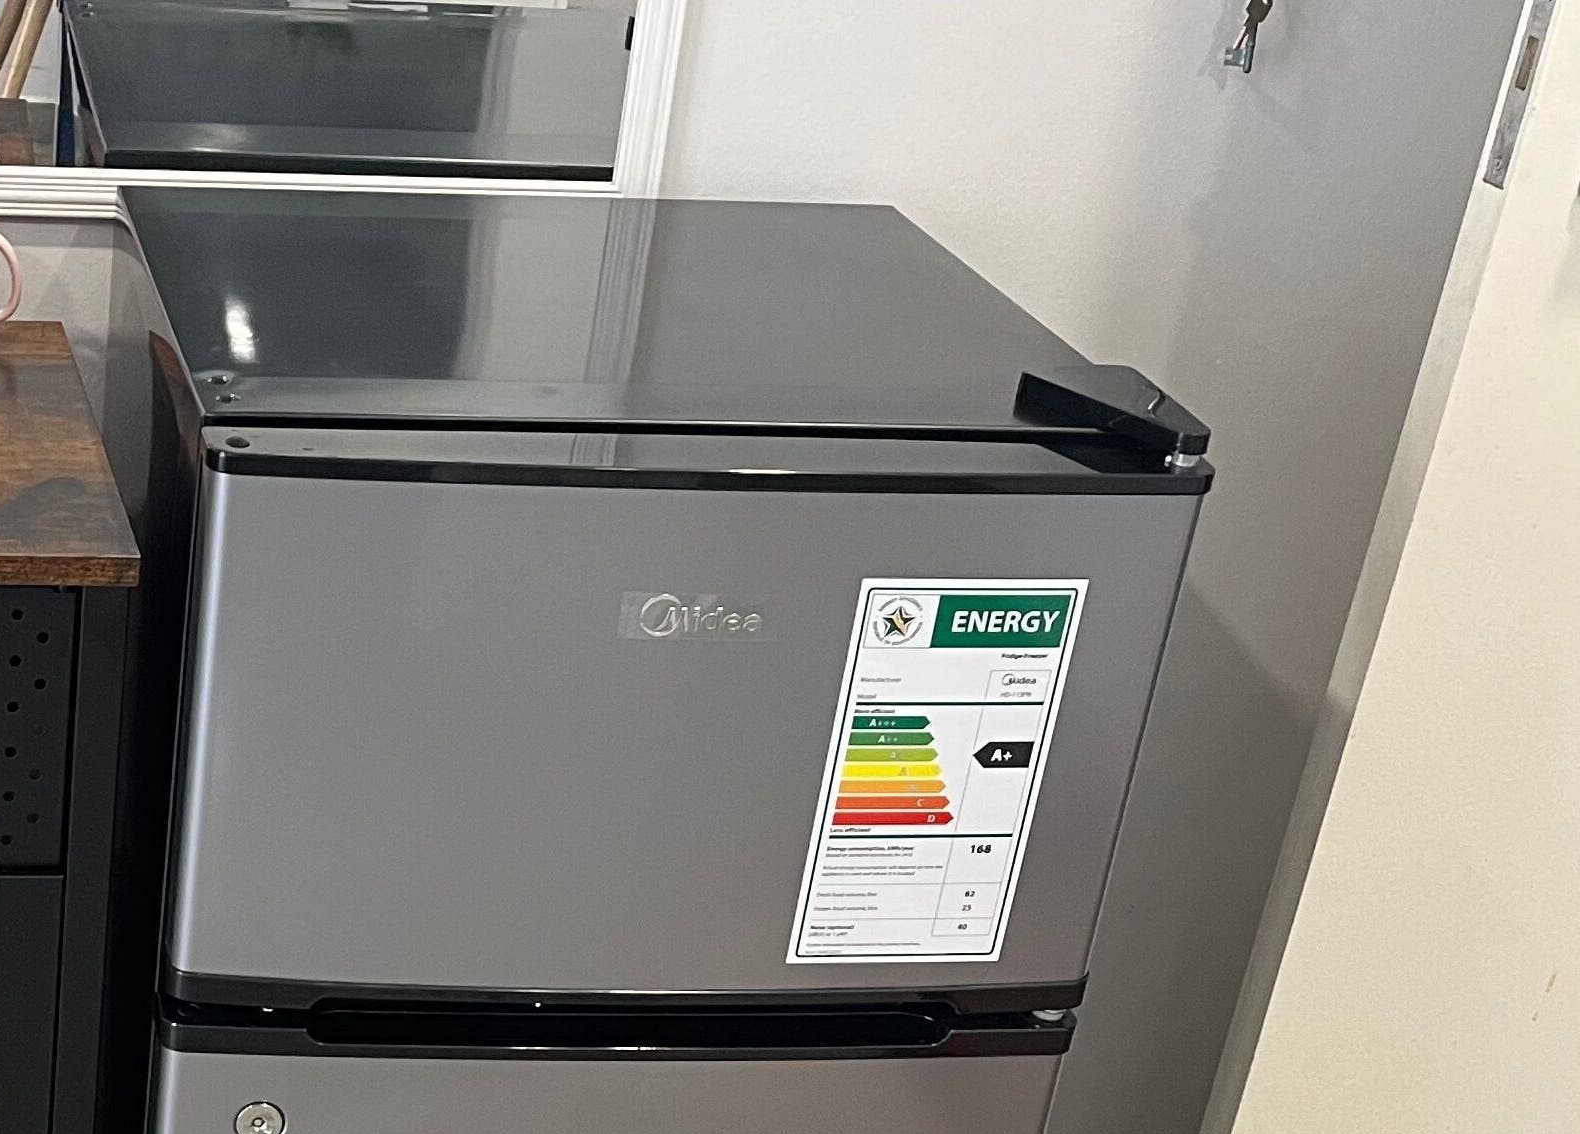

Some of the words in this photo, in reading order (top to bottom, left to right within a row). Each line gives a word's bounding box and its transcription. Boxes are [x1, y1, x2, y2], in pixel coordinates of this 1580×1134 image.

[639, 593, 761, 637] Midea
[951, 610, 1061, 633] ENERGY
[1001, 673, 1037, 686] Midea
[990, 748, 1013, 762] A+
[927, 814, 936, 823] D
[970, 844, 992, 854] 168
[964, 890, 975, 898] 62
